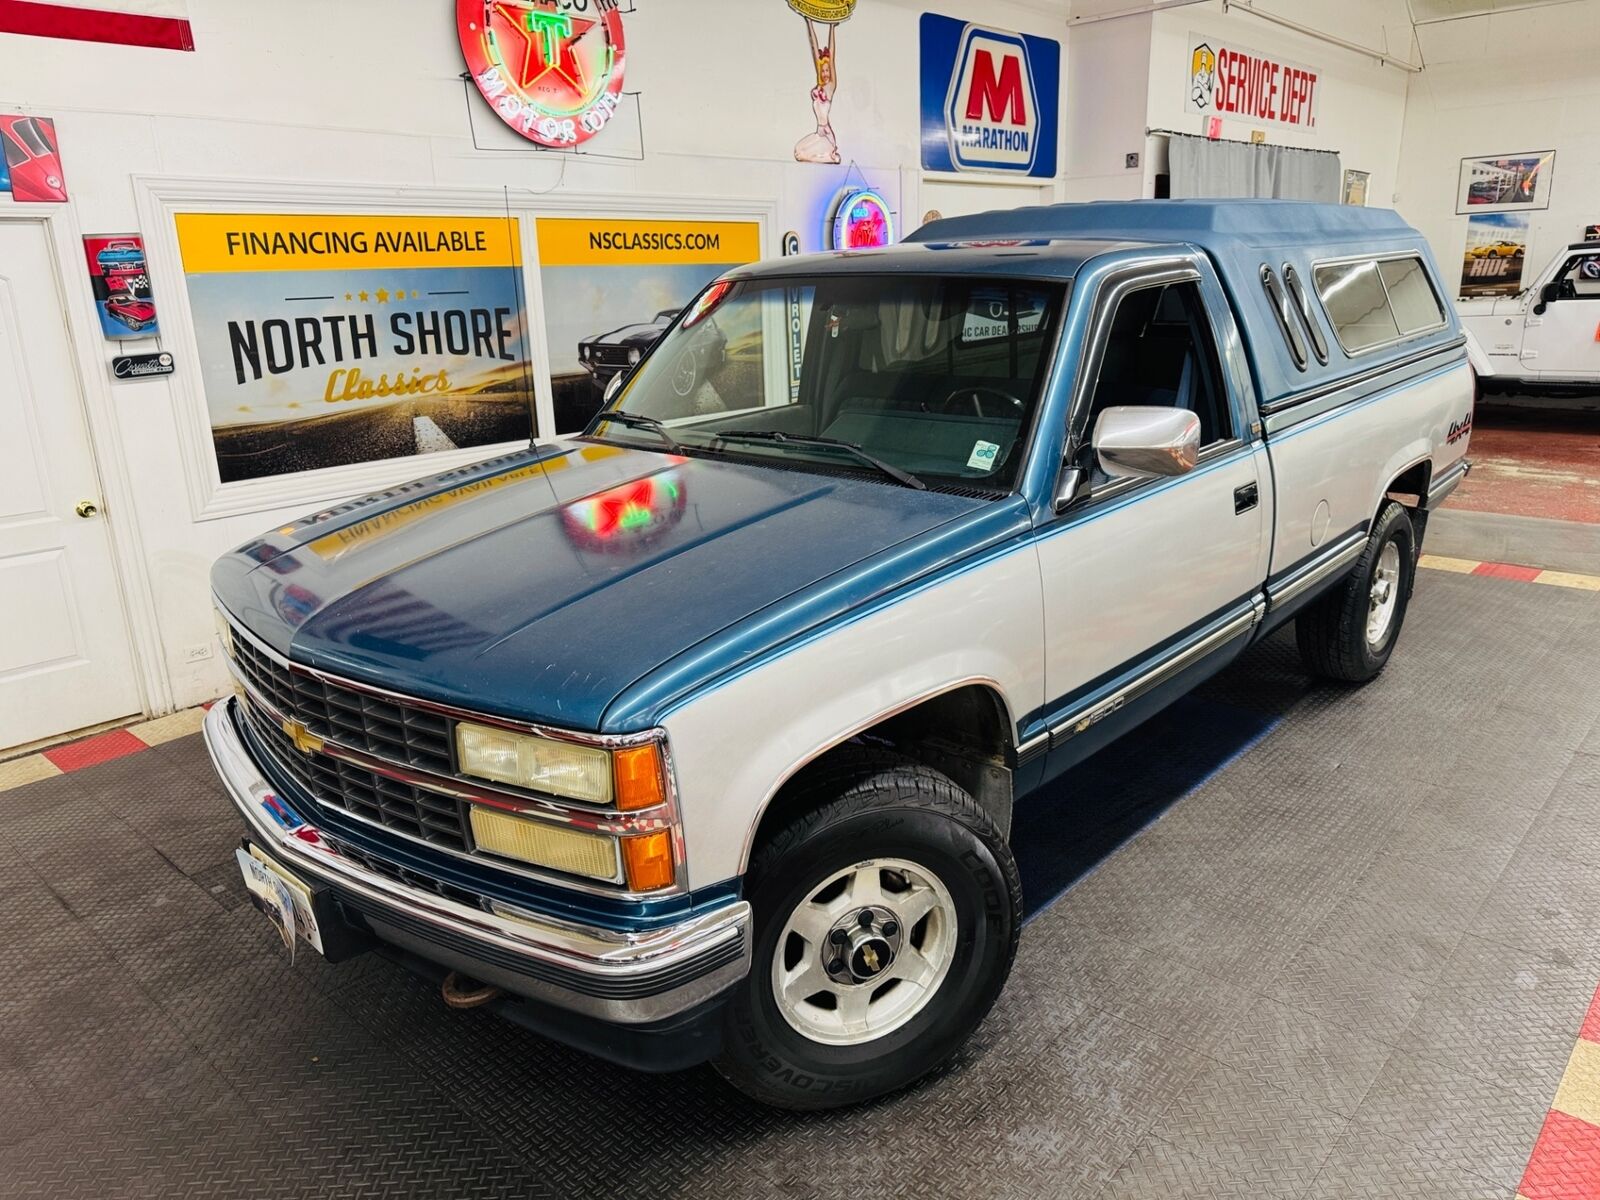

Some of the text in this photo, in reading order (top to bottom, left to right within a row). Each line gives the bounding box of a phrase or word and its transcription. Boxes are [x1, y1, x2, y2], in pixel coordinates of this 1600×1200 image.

[965, 49, 1026, 126] M
[1215, 48, 1317, 128] SERVICE DEPT.
[476, 66, 622, 143] MOTOR OIL
[961, 125, 1029, 152] MARATHON
[226, 230, 487, 256] FINANCING AVAILABLE
[588, 231, 721, 251] NSCLASSICS.COM
[1469, 257, 1510, 277] RIDE
[227, 307, 515, 385] NORTH SHORE
[973, 325, 990, 337] CAR
[323, 367, 453, 404] Classics
